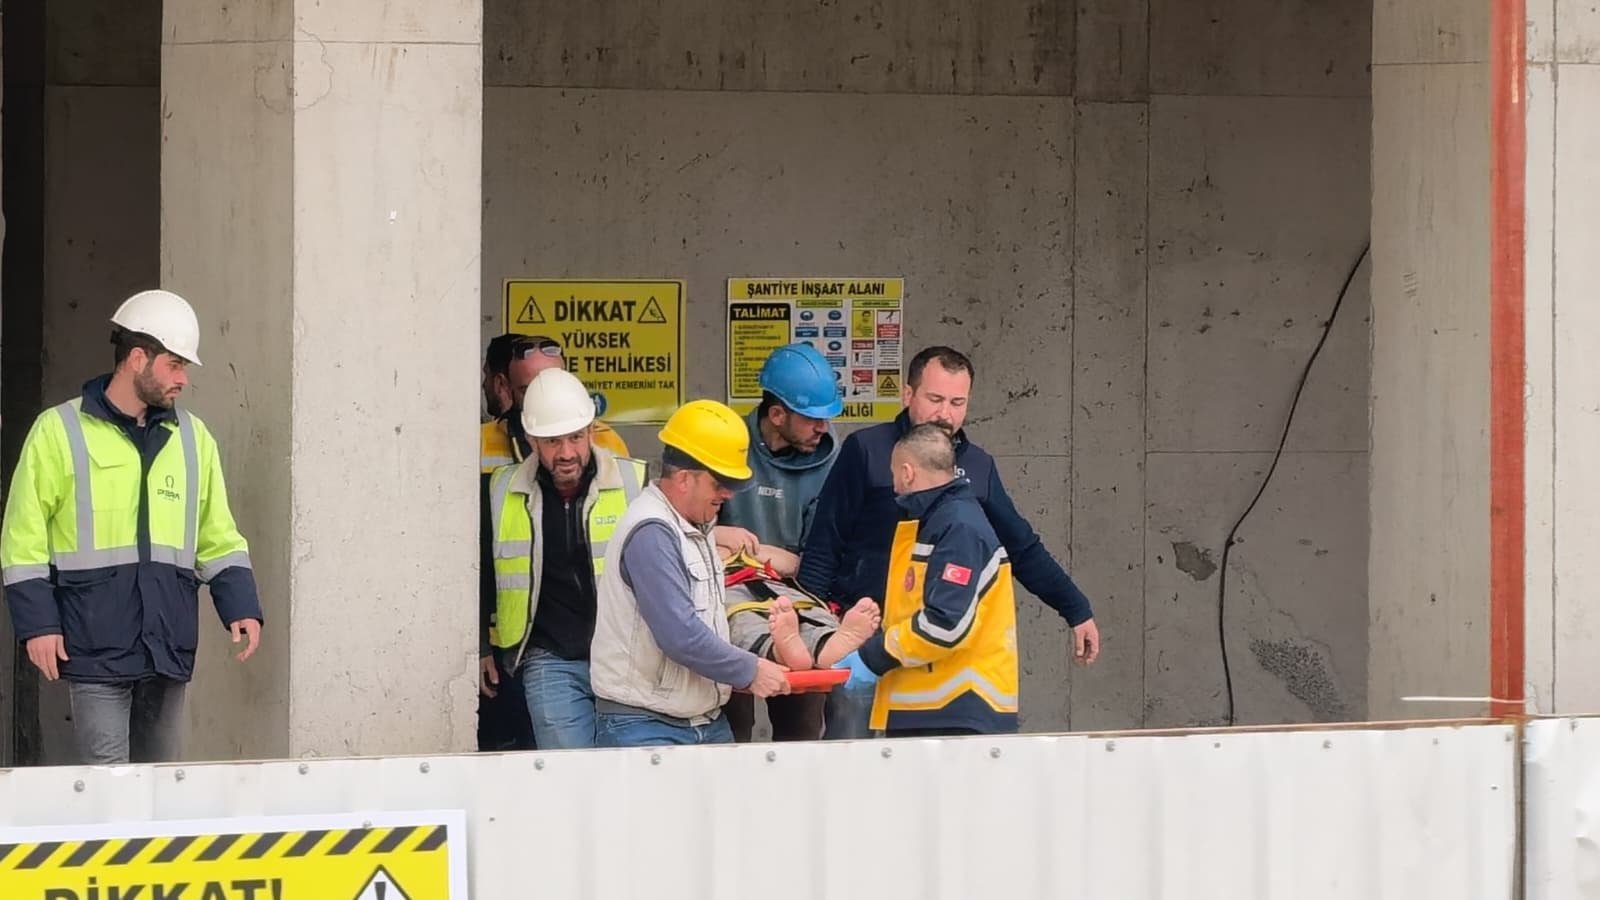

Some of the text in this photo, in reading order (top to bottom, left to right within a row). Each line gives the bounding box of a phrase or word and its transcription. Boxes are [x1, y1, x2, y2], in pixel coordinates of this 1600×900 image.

[747, 280, 885, 298] ŞANTİYE İNŞAAT ALANI
[554, 296, 637, 322] DİKKAT
[733, 305, 787, 319] TALİMAT
[562, 329, 631, 348] YÜKSEK
[584, 352, 671, 373] TEHLİKESİ
